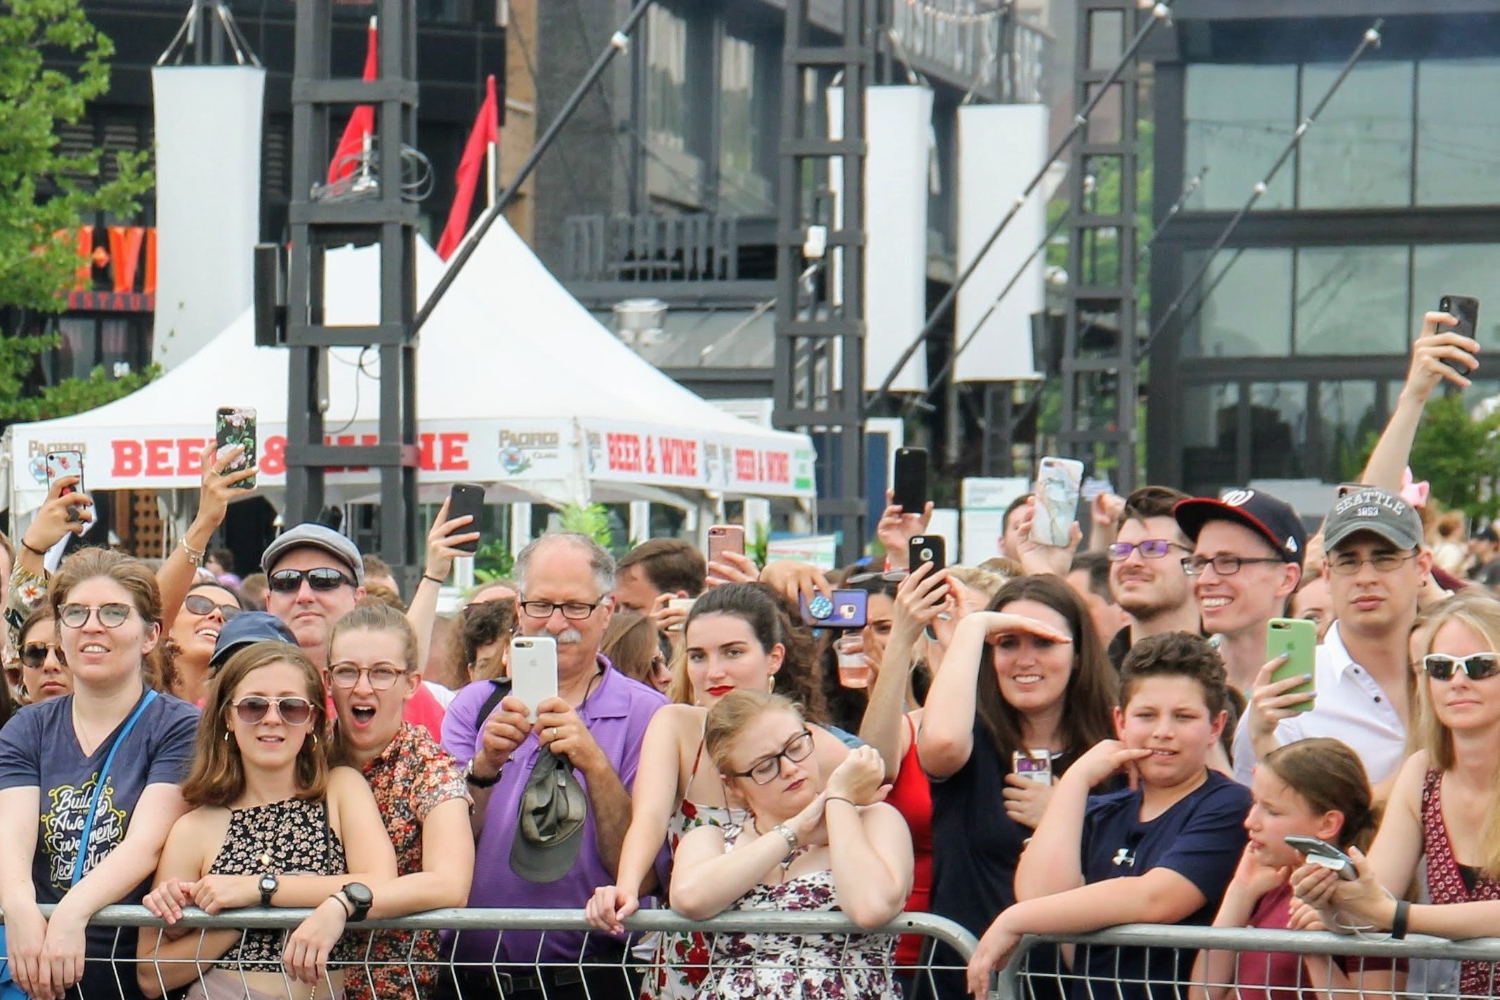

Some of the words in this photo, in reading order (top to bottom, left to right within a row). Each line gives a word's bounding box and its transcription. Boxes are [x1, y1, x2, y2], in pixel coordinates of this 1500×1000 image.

[499, 430, 560, 448] PACIFICO
[607, 432, 641, 472] BEER
[646, 434, 656, 474] &
[660, 437, 697, 477] WINE
[110, 438, 217, 477] BEE
[1336, 491, 1406, 516] SEATTLE
